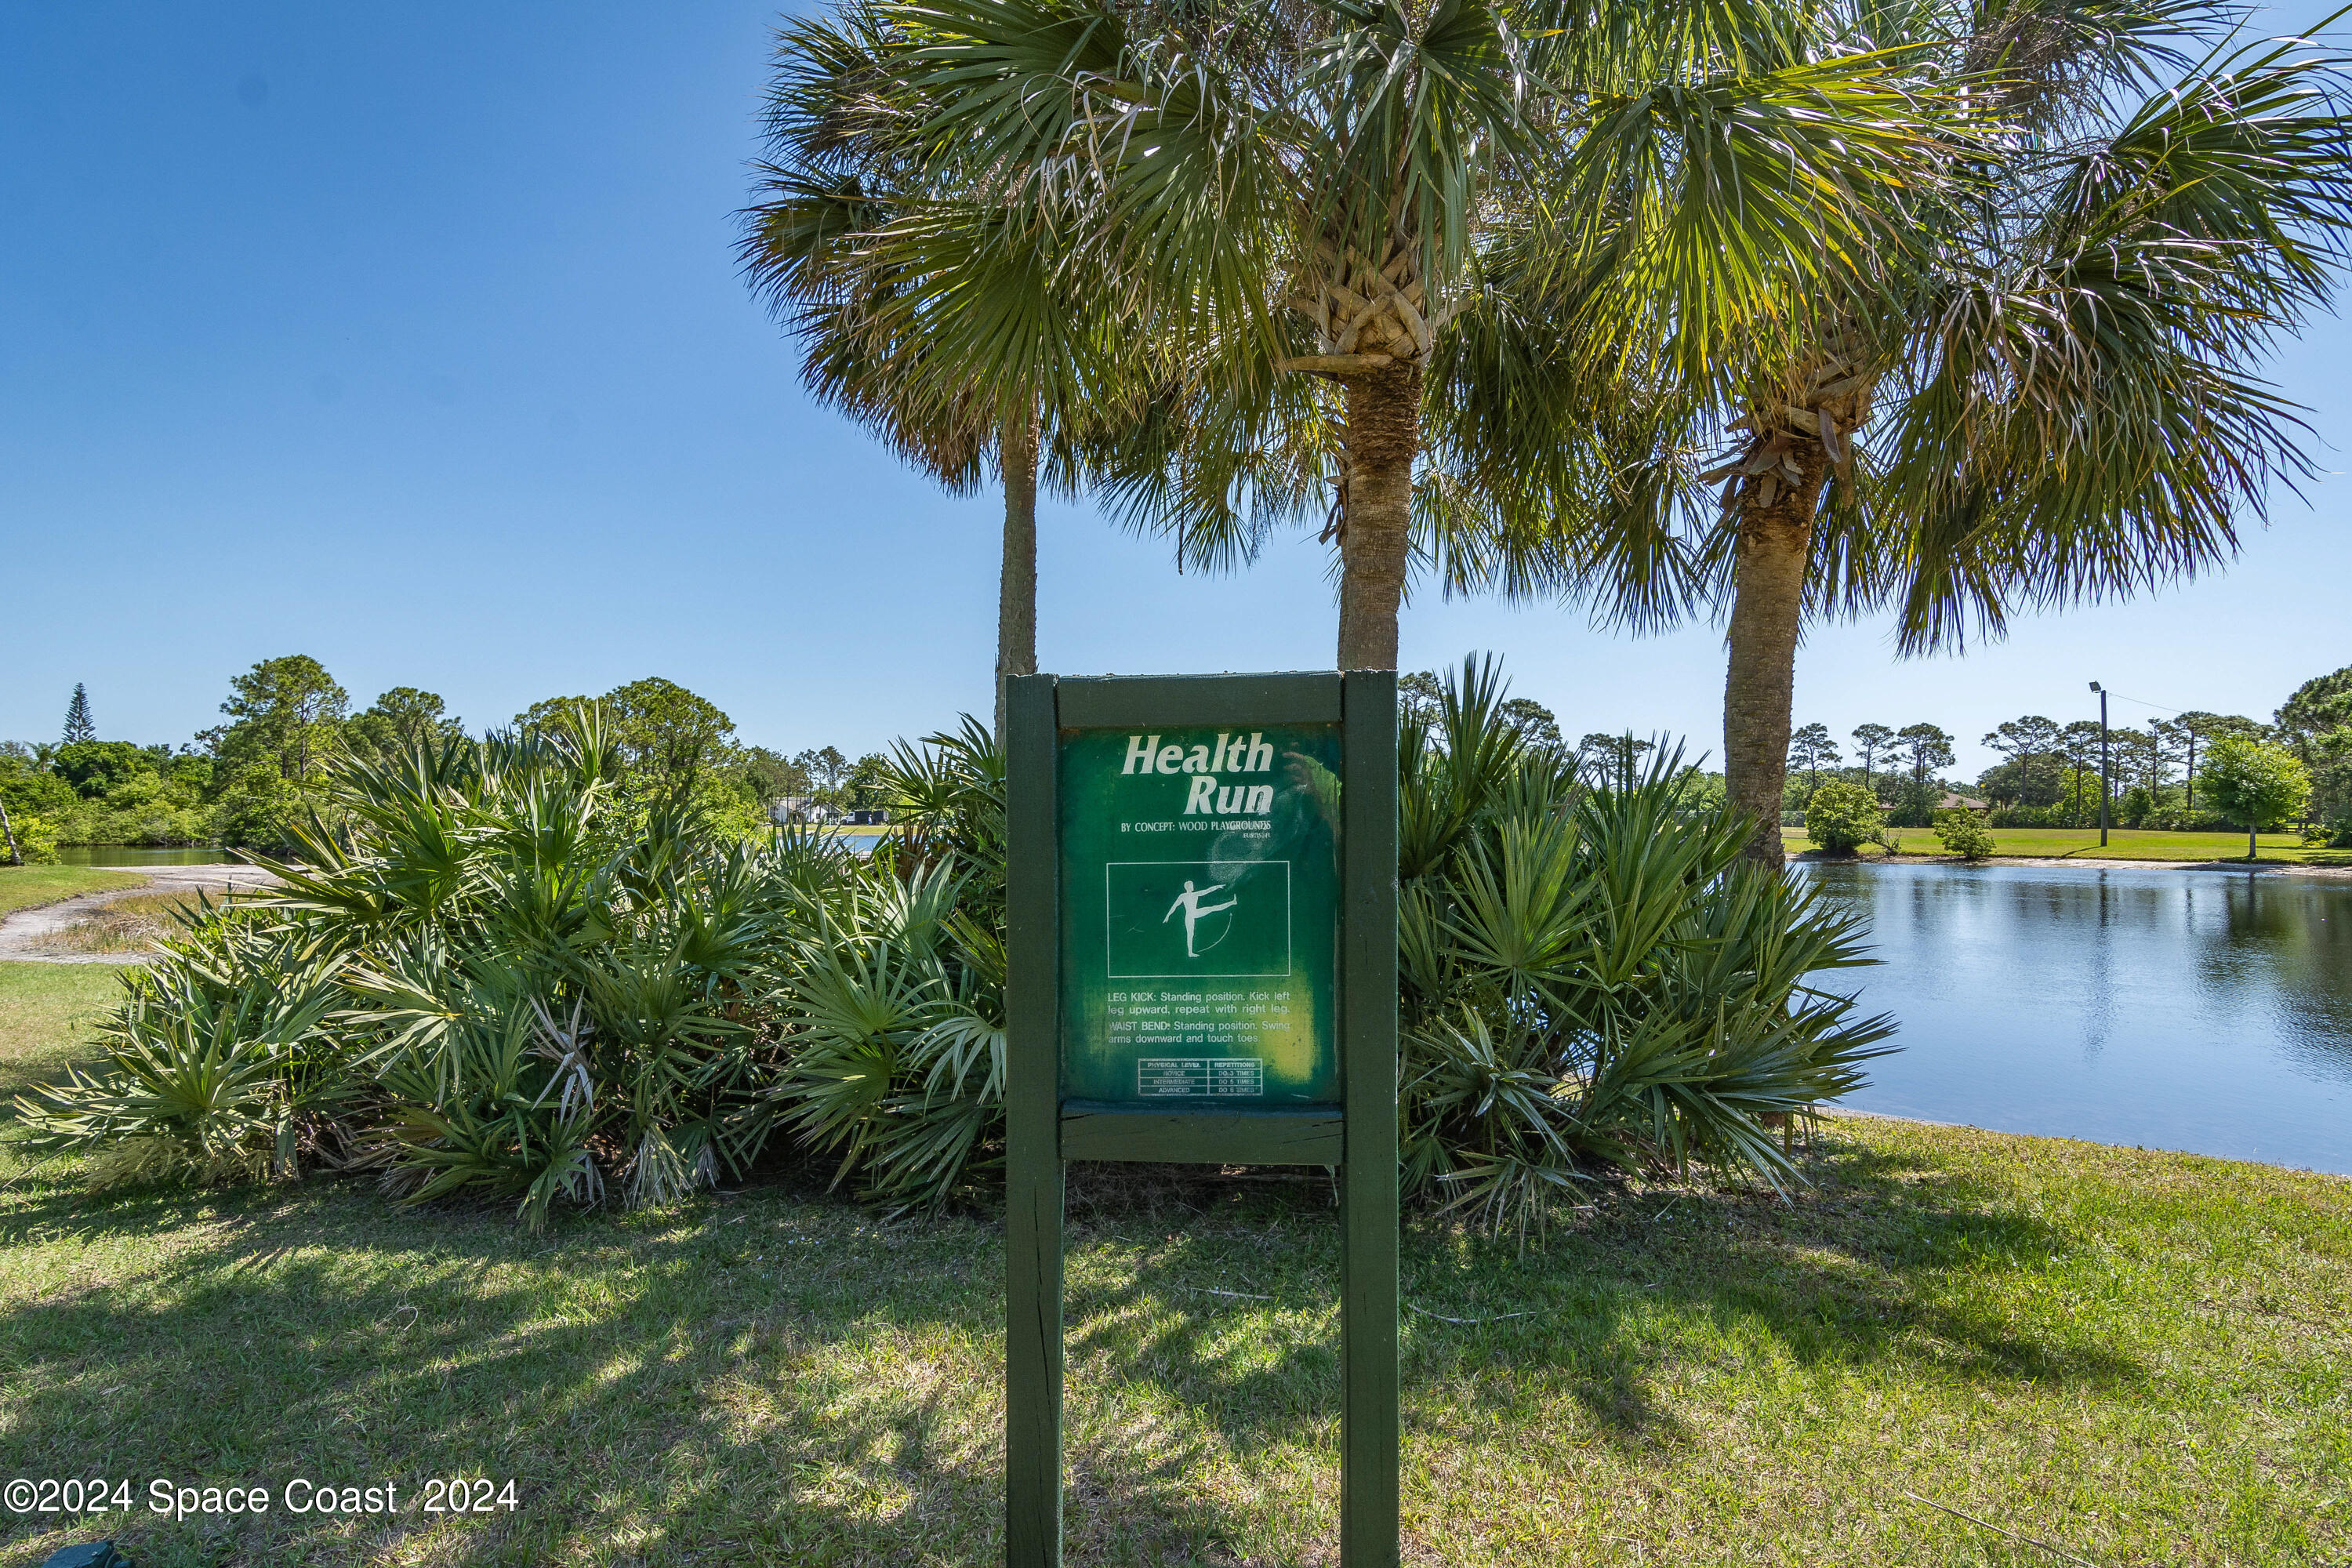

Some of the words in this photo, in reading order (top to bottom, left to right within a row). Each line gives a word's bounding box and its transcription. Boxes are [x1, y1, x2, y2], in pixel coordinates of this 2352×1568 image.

[1120, 732, 1274, 775] Health
[1183, 775, 1274, 815] Run
[1121, 822, 1131, 832] BY
[1134, 822, 1175, 832] CONCEPT:
[1178, 821, 1207, 831] WOOD
[1210, 820, 1272, 831] PLAYGROUNDS
[1108, 992, 1127, 1002] LEG
[1131, 992, 1156, 1002] KICK:
[1160, 991, 1202, 1004] Standing
[1205, 991, 1245, 1004] position.
[1249, 991, 1270, 1001] Kick
[1274, 991, 1290, 1001] left
[1108, 1005, 1124, 1016] leg
[1129, 1004, 1170, 1015] upward,
[1175, 1005, 1210, 1014] repeat
[1215, 1004, 1237, 1014] with
[1242, 1004, 1266, 1015] right
[1271, 1004, 1290, 1014] leg.
[1109, 1022, 1137, 1032] WAIST
[1142, 1022, 1171, 1032] BEND:
[1174, 1021, 1214, 1032] Standing
[1218, 1021, 1257, 1032] position.
[1261, 1021, 1290, 1032] Swing
[1135, 1034, 1182, 1044] downward
[1186, 1034, 1203, 1043] and
[1207, 1034, 1233, 1043] touch
